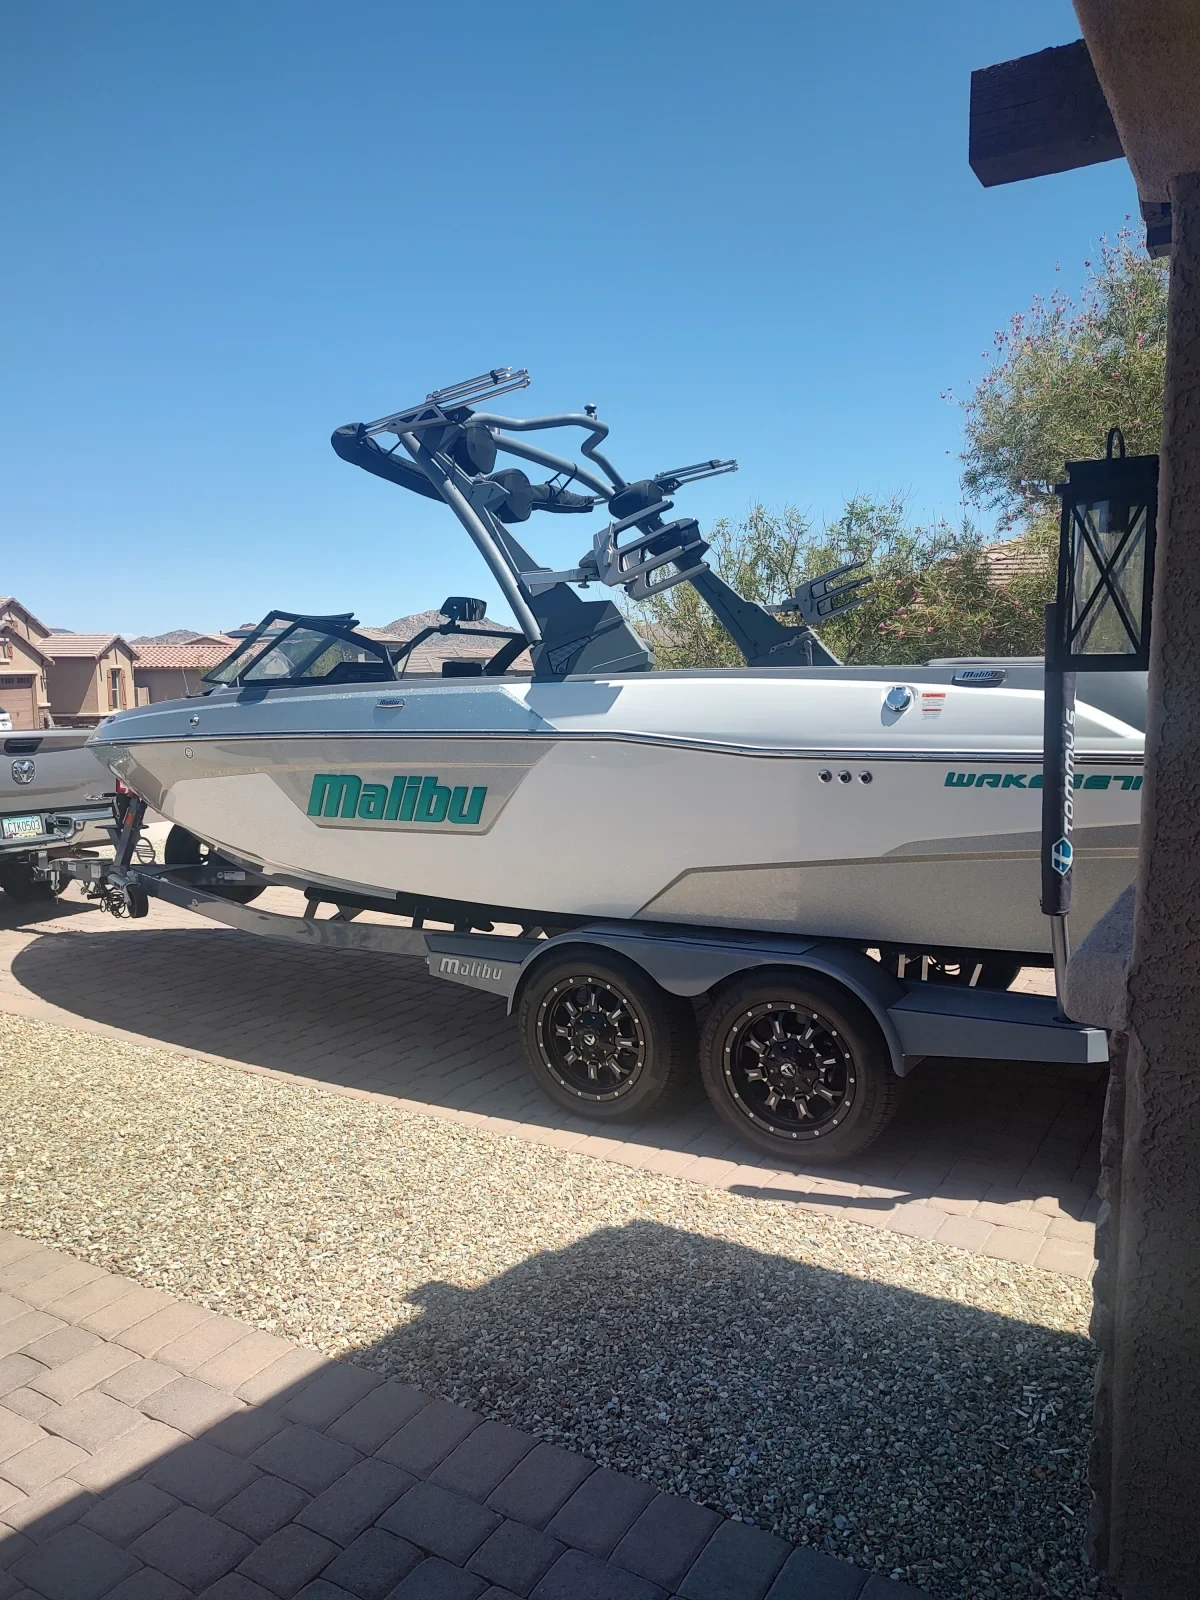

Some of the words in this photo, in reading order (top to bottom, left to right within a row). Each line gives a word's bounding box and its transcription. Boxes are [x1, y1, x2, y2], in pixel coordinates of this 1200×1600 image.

[962, 671, 998, 679] Malibu
[307, 773, 488, 825] Malibu
[439, 957, 502, 981] Malibu
